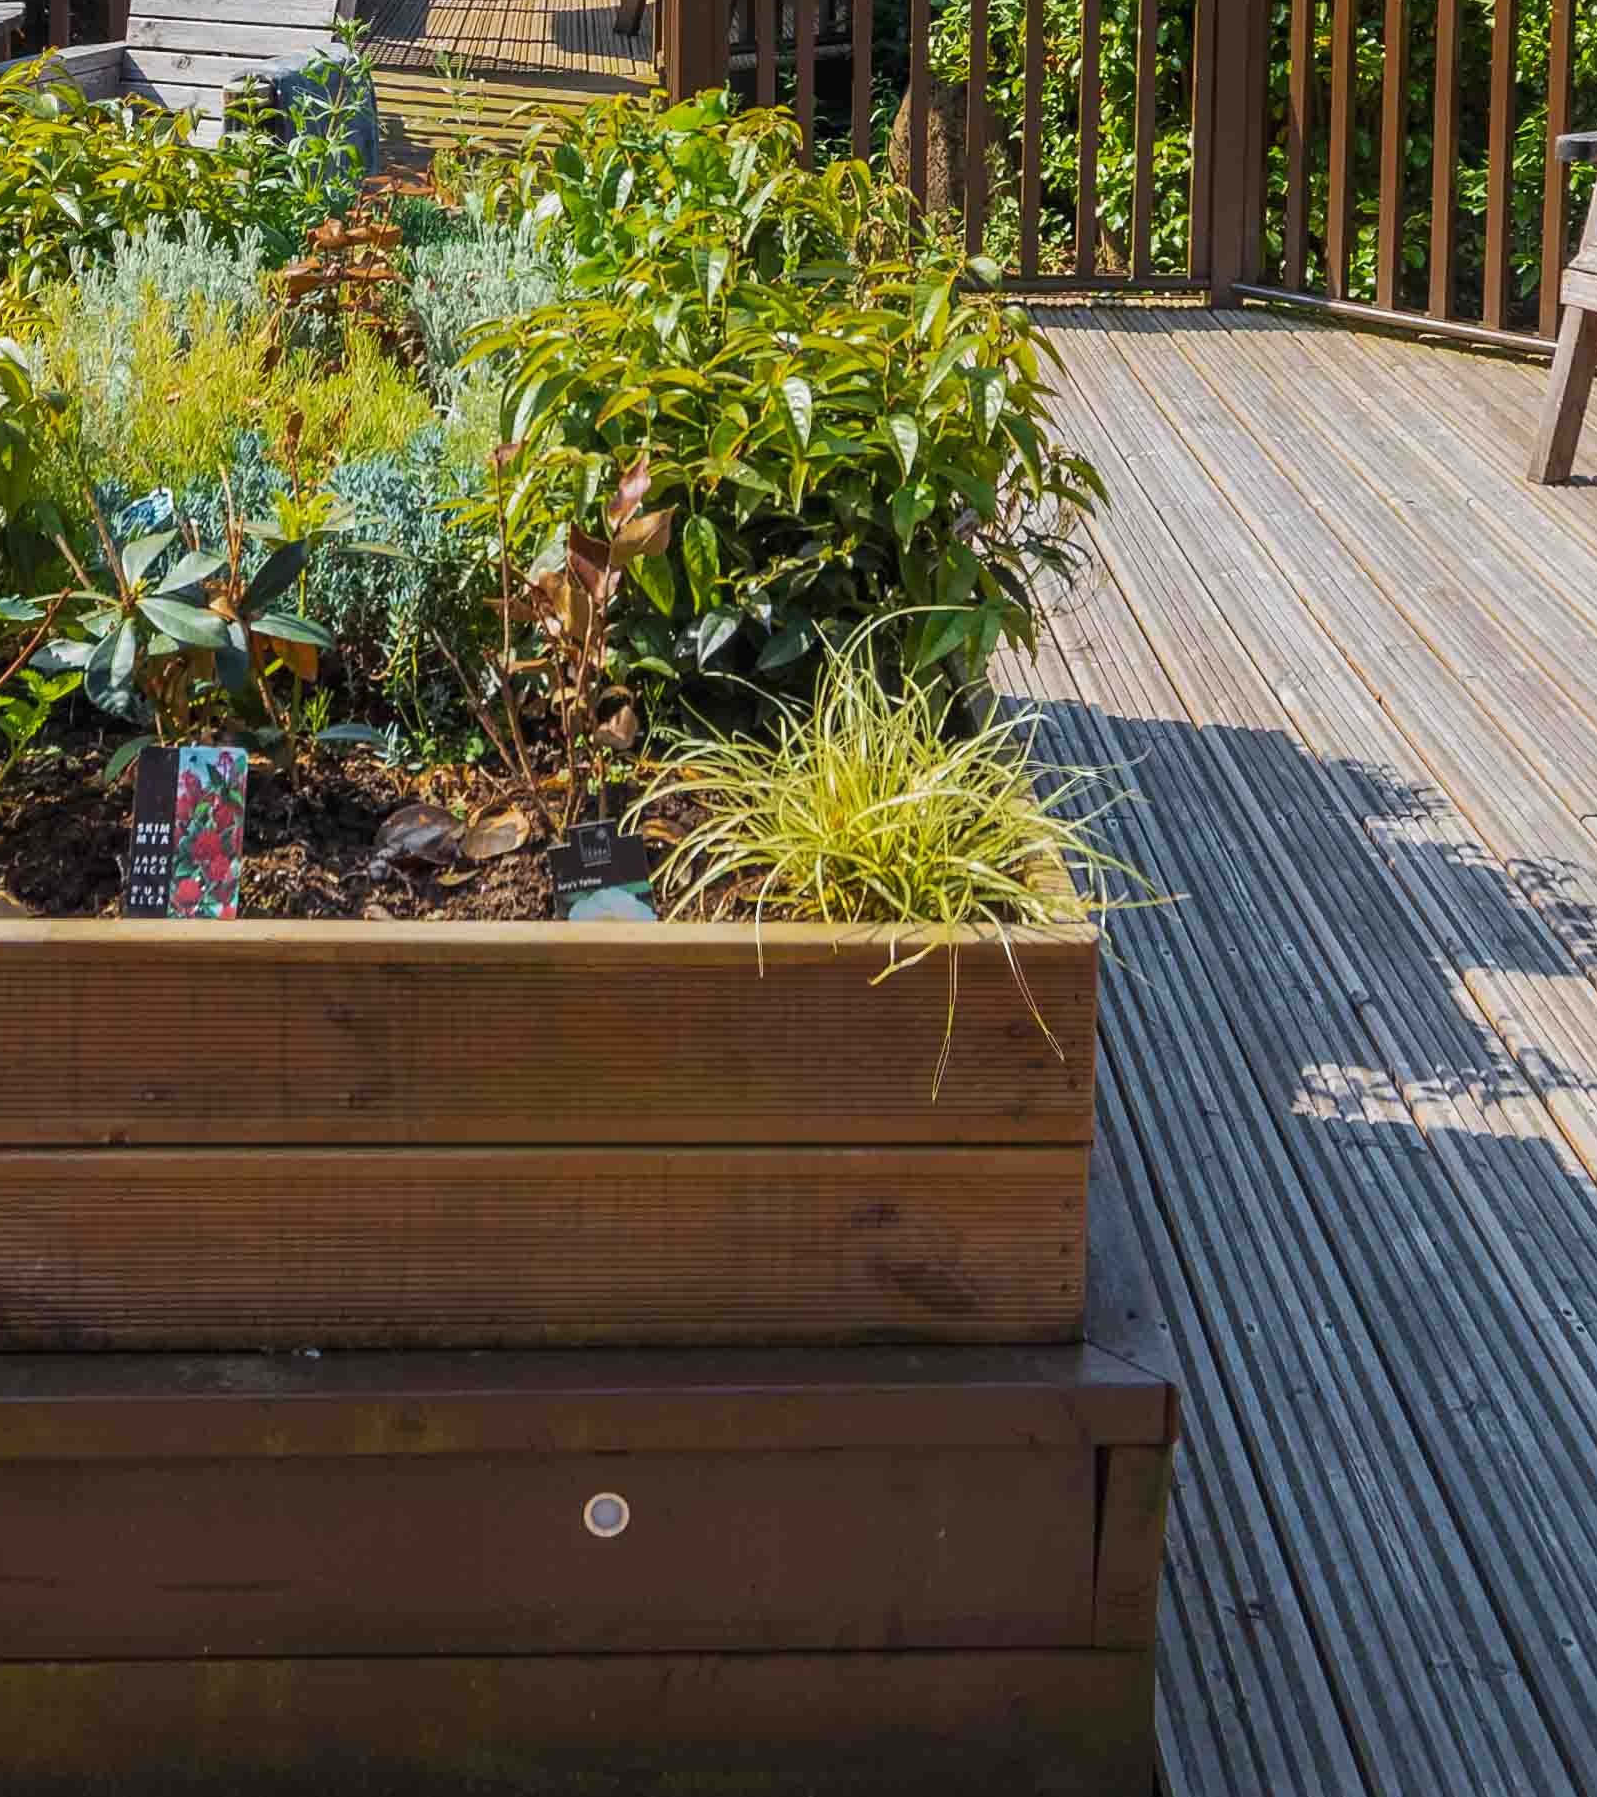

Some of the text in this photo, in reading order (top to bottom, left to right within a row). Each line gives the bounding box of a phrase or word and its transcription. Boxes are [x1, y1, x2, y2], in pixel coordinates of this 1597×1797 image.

[137, 823, 170, 834] SKIM
[136, 834, 169, 844] MIA
[134, 855, 168, 865] JAPO
[133, 865, 166, 875] NICA
